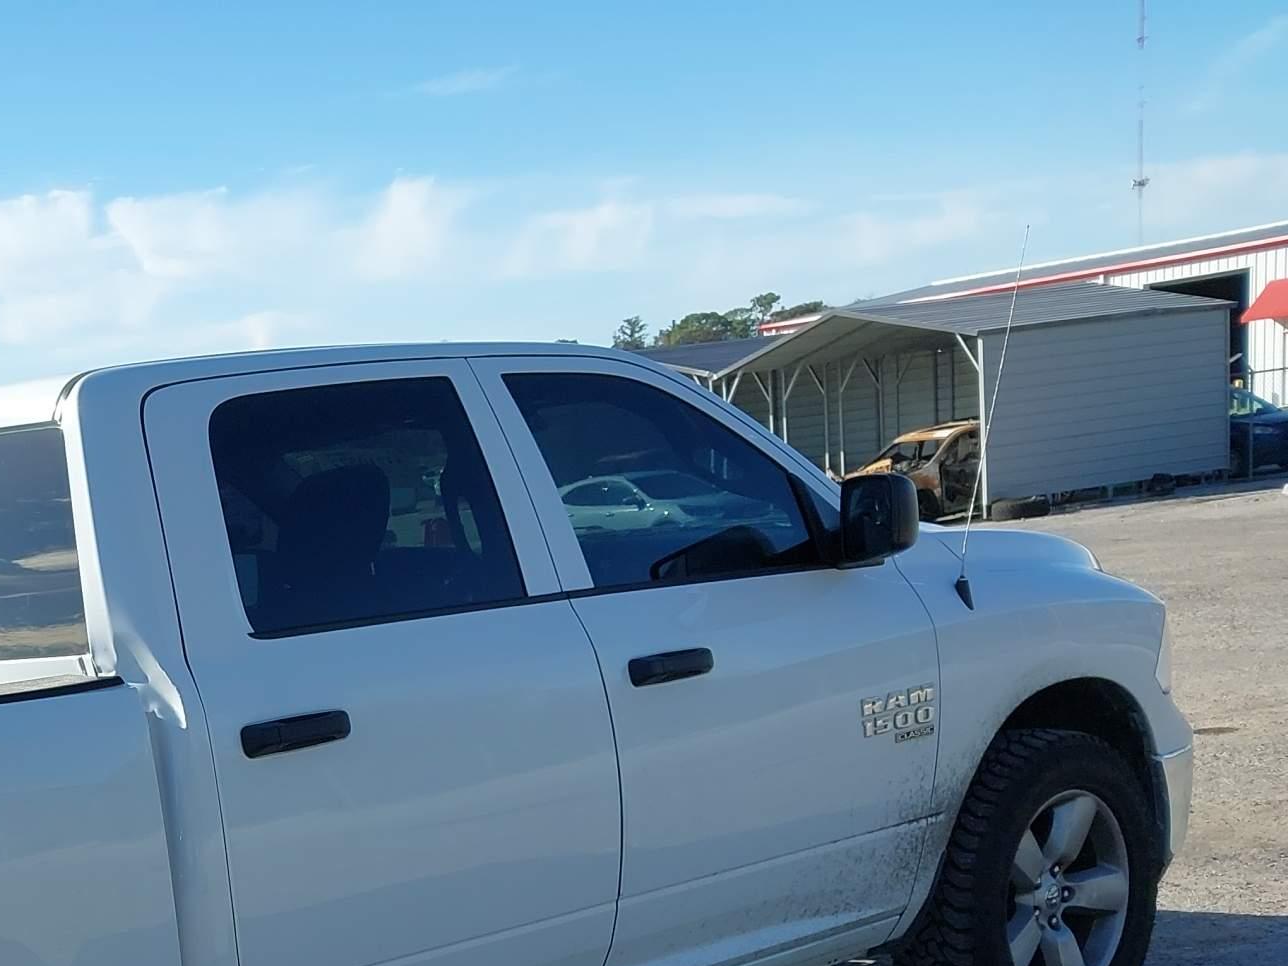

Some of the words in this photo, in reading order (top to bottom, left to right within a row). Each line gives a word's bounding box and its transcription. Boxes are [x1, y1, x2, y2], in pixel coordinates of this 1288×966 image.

[860, 682, 936, 717] RAM
[861, 705, 936, 738] 1500
[896, 725, 934, 742] CLASSIC
